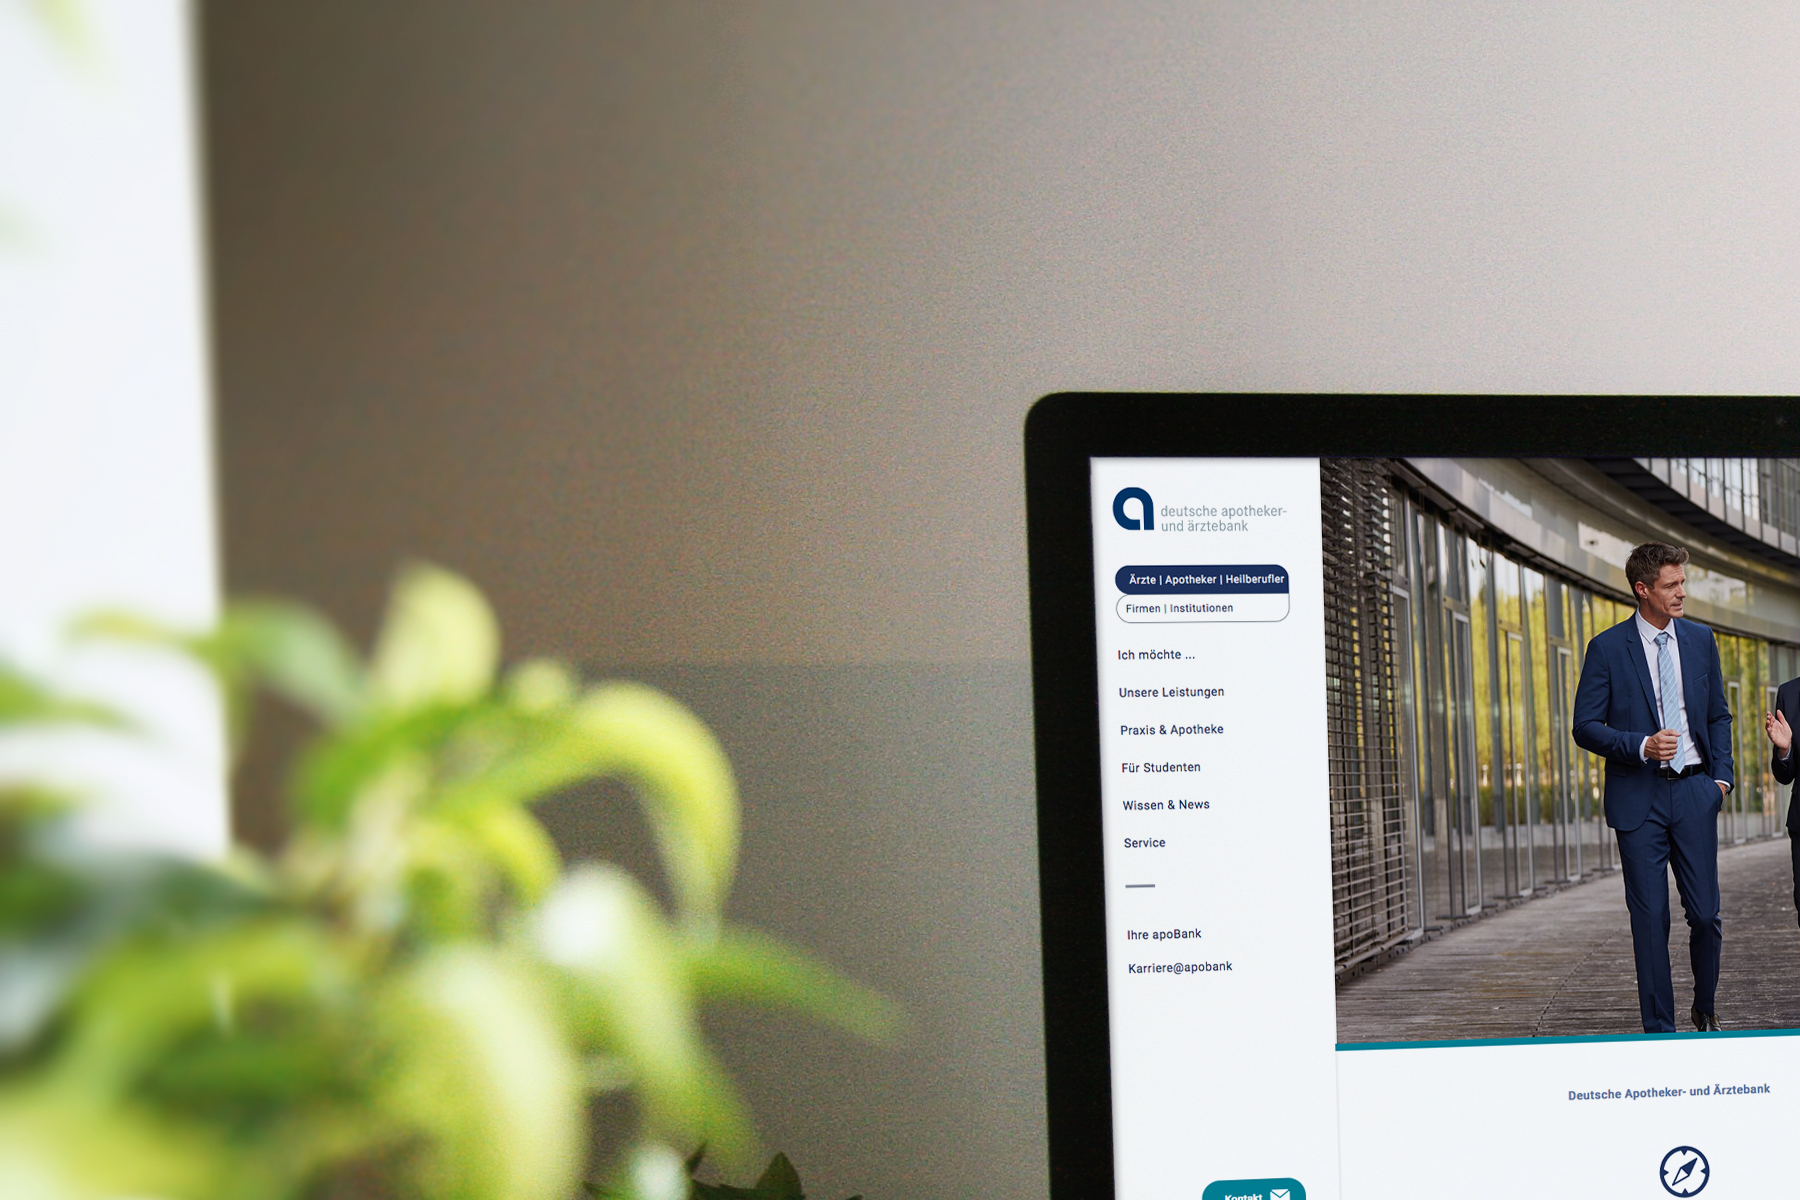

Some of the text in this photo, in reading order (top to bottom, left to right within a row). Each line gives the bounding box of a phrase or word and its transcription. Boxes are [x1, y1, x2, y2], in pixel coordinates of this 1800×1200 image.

[1161, 505, 1287, 519] deutsche apotheker-
[1161, 520, 1248, 532] und ärztebank
[1129, 574, 1156, 585] Ärzte
[1165, 574, 1217, 587] Apotheker
[1226, 574, 1285, 584] Heilberufler
[1126, 604, 1161, 613] Firmen
[1170, 604, 1234, 613] Institutionen
[1118, 650, 1135, 660] Ich
[1138, 649, 1182, 660] möchte
[1119, 687, 1225, 700] Unsere Leistungen
[1120, 724, 1224, 738] Praxis & Apotheke
[1121, 762, 1201, 773] Für Studenten
[1123, 799, 1210, 811] Wissen & News
[1124, 838, 1166, 849] Service
[1127, 929, 1202, 942] Ihre apoBank
[1128, 962, 1233, 975] Karriere@apobank
[1568, 1083, 1771, 1101] Deutsche Apotheker- und Ärztebank
